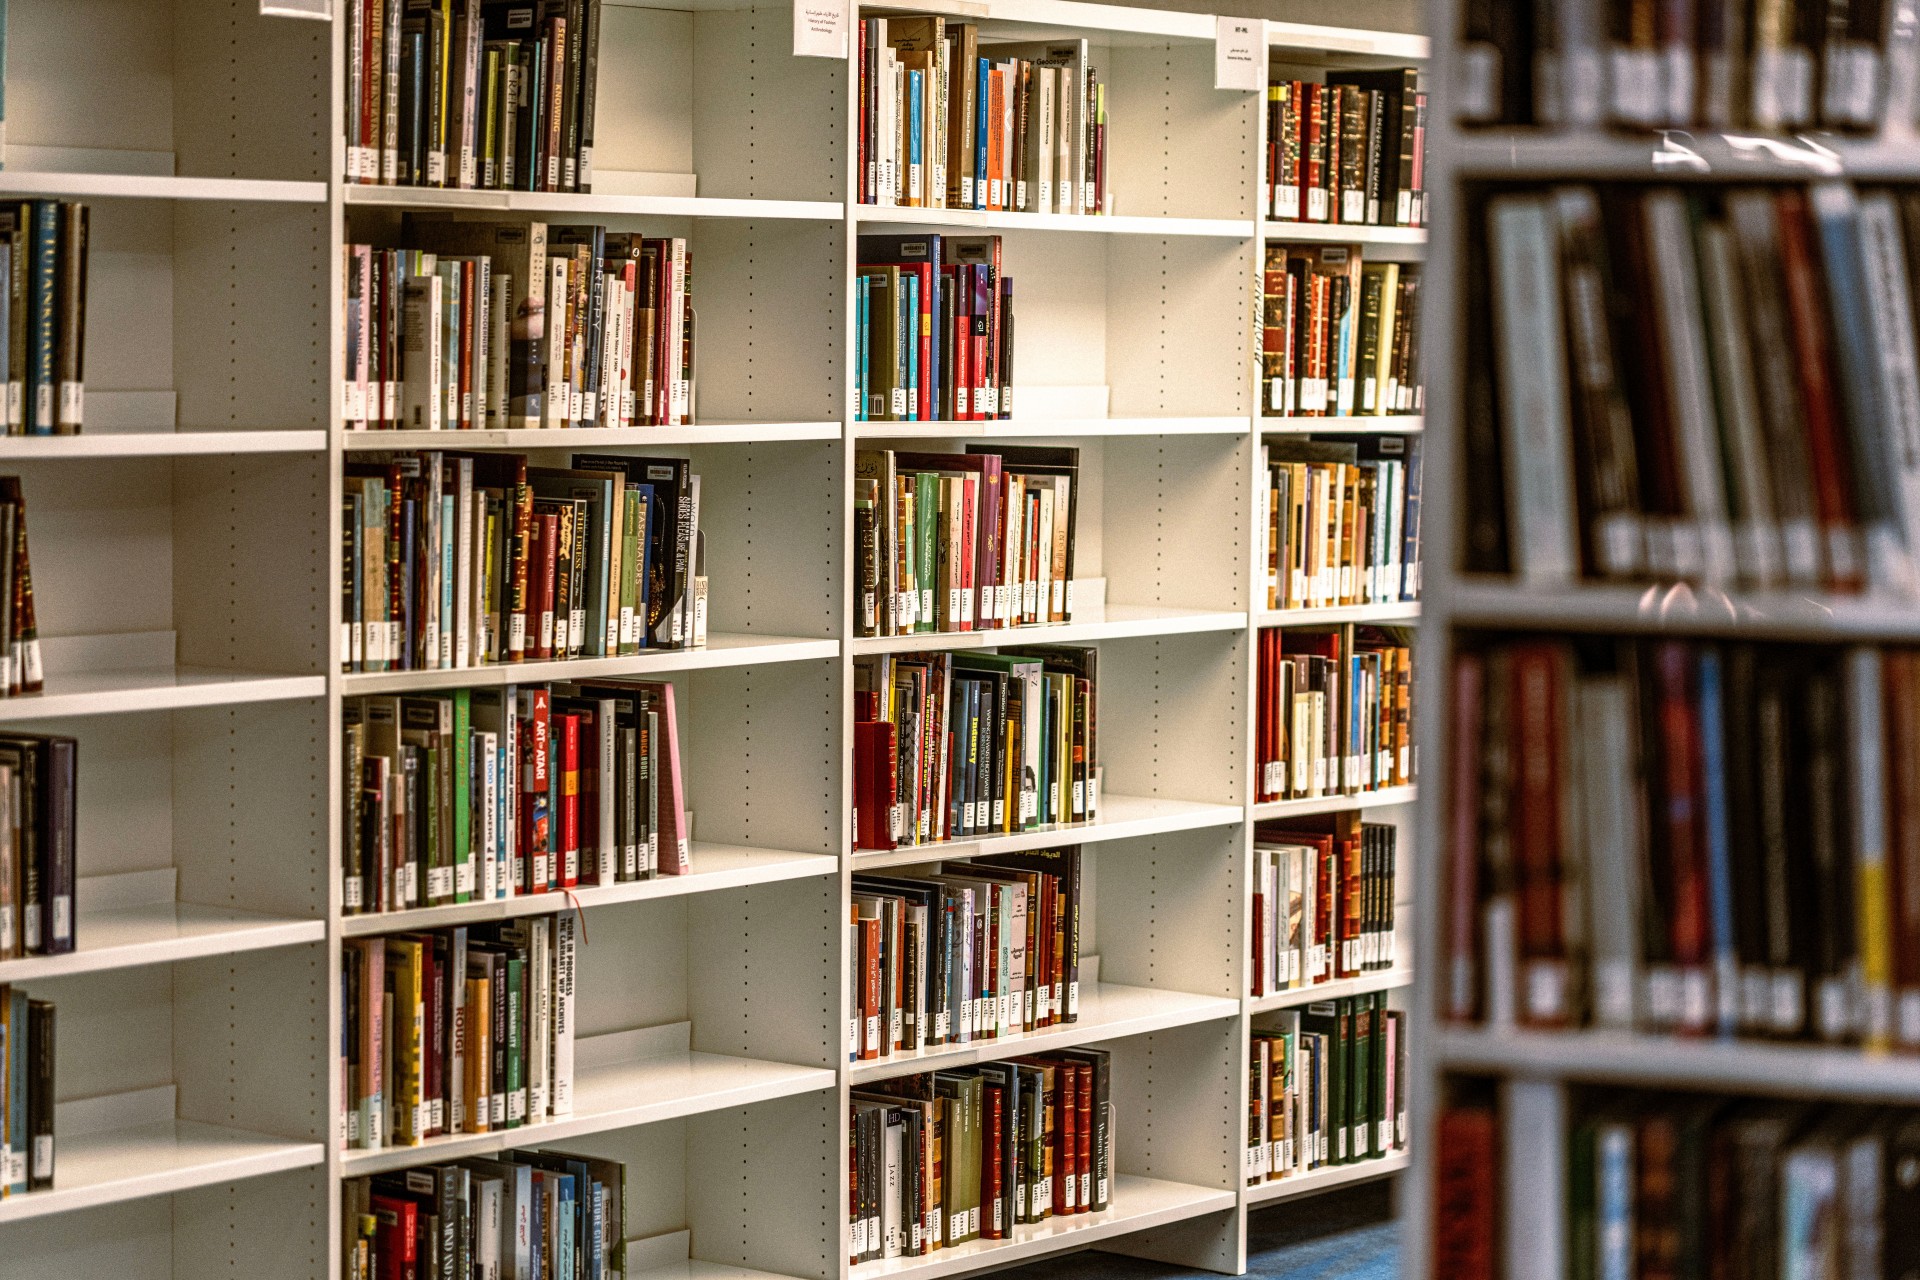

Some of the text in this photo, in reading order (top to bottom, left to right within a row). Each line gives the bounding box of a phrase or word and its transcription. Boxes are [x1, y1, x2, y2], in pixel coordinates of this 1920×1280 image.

[386, 13, 400, 146] STEPPES
[554, 27, 566, 132] SEEING KNOWING
[370, 61, 380, 144] MOUNTAINS
[1020, 92, 1030, 134] Medina
[1374, 118, 1382, 164] MUSICAL
[1372, 166, 1380, 199] HUMA
[592, 257, 604, 331] PREPPY
[356, 317, 364, 365] FASHION
[678, 496, 688, 519] SHOES
[548, 526, 556, 558] Dreaming
[575, 510, 584, 569] THE DRESS
[636, 511, 646, 585] FASCINATORS
[676, 521, 686, 552] PLEASURE
[675, 558, 684, 572] PAIN
[560, 572, 568, 604] FIERCE
[536, 720, 546, 742] ART
[968, 716, 978, 764] Industry
[536, 750, 546, 780] ATARI
[640, 757, 648, 780] BODIES
[566, 944, 574, 952] IN
[454, 1006, 464, 1059] ROUGE
[510, 992, 518, 1048] SUSTAINABILITY
[888, 1113, 901, 1123] HD
[444, 1222, 454, 1274] MIND AND
